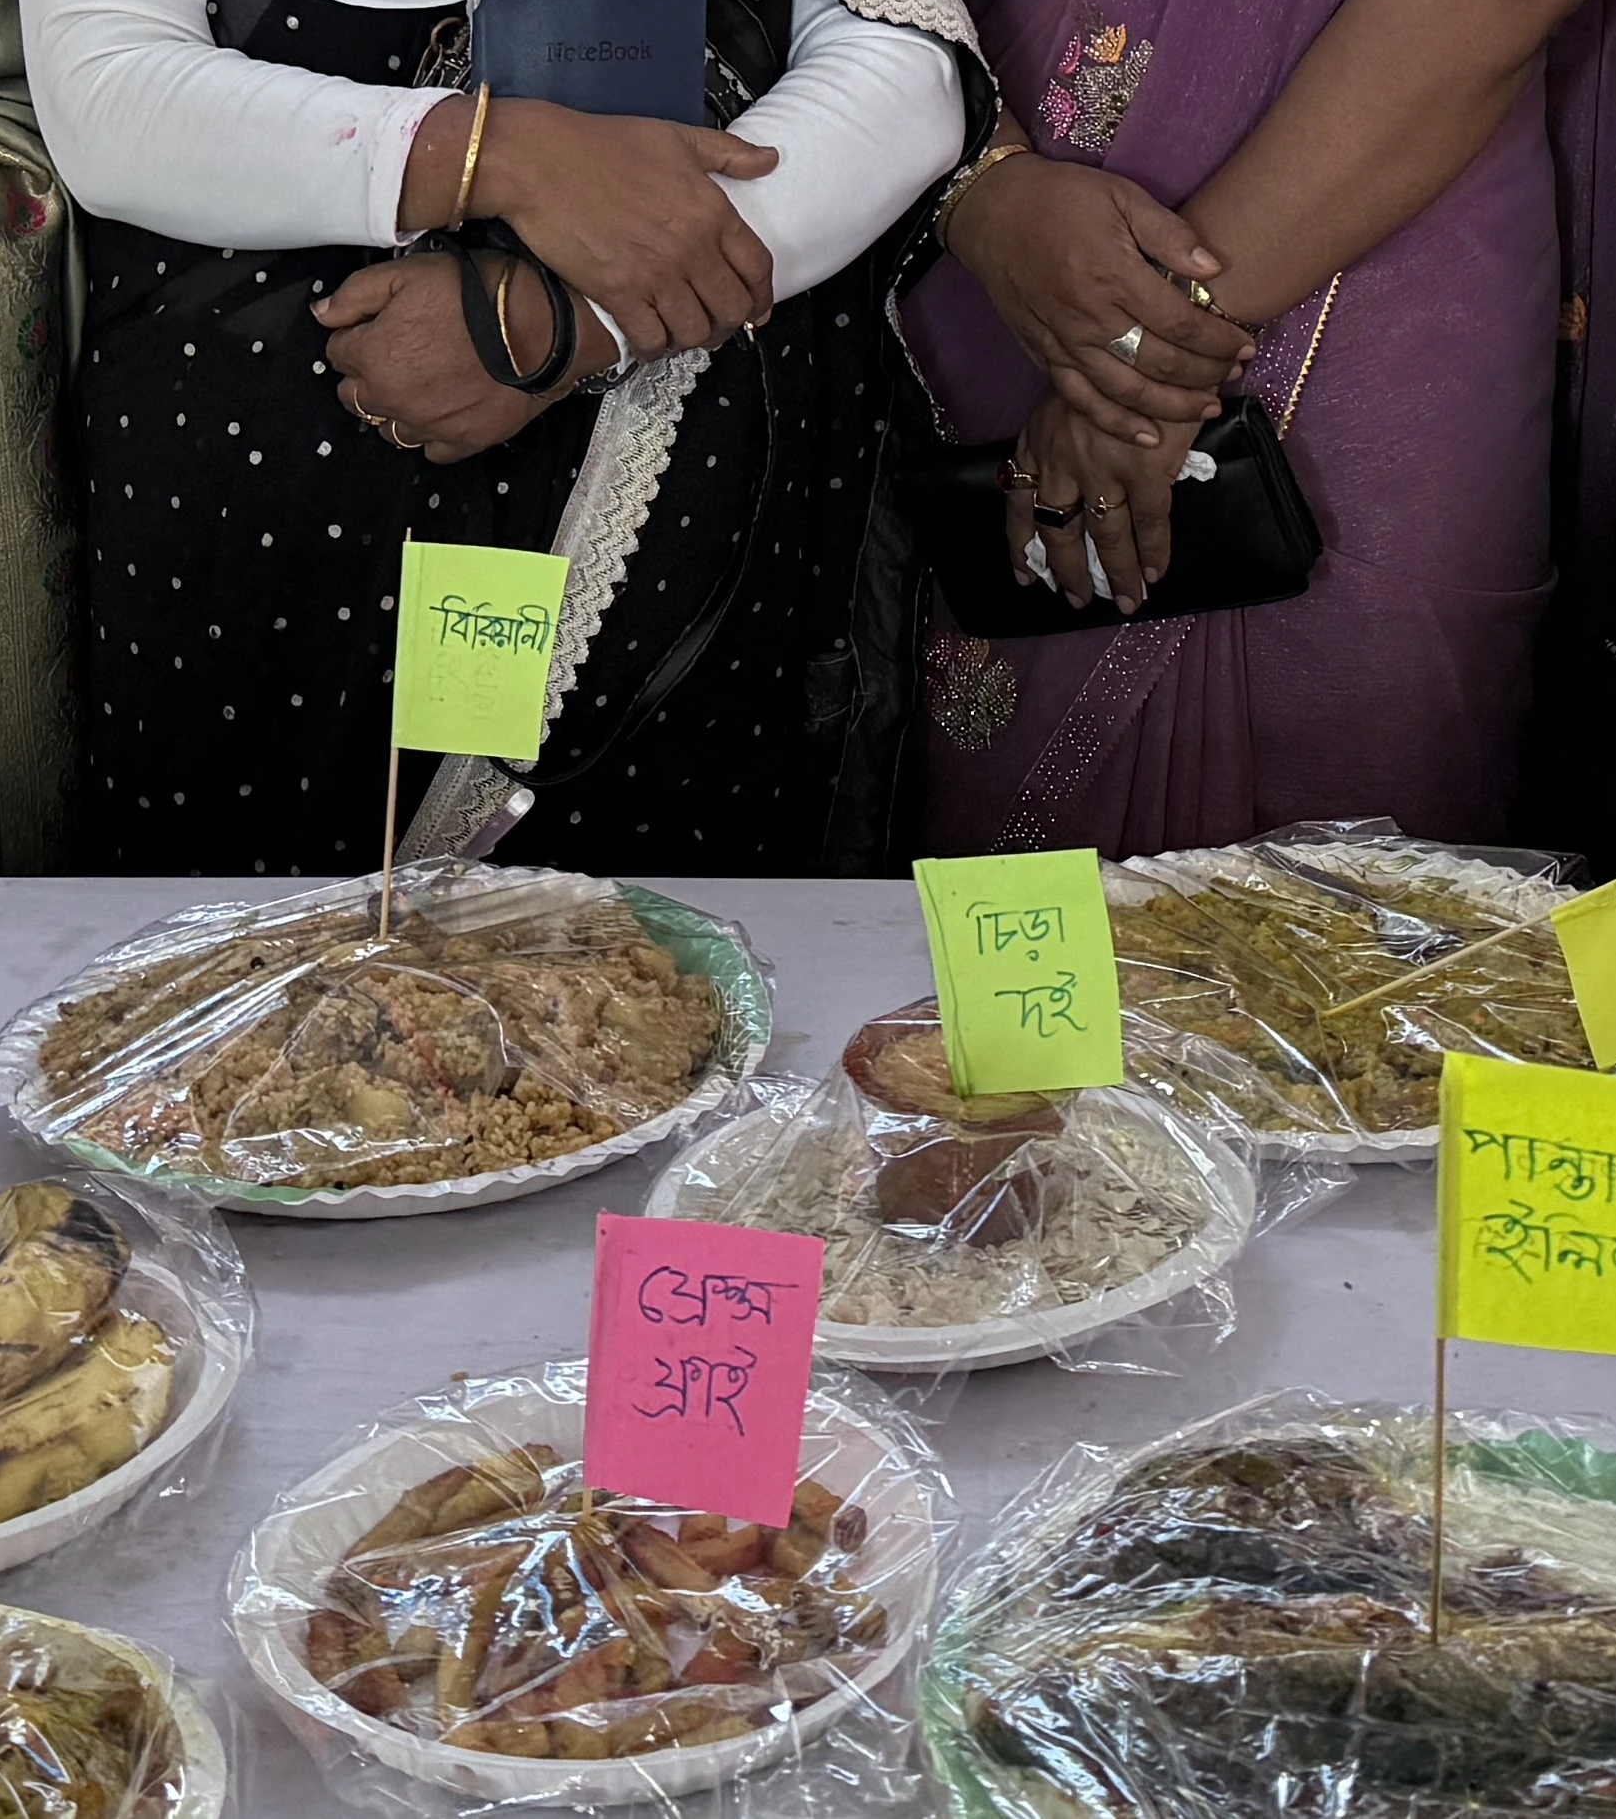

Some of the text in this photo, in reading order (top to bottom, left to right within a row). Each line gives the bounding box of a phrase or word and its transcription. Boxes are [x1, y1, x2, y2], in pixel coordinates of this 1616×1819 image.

[546, 40, 652, 63] NoteBook
[966, 901, 1065, 961] চিড়া
[994, 971, 1088, 1038] দই
